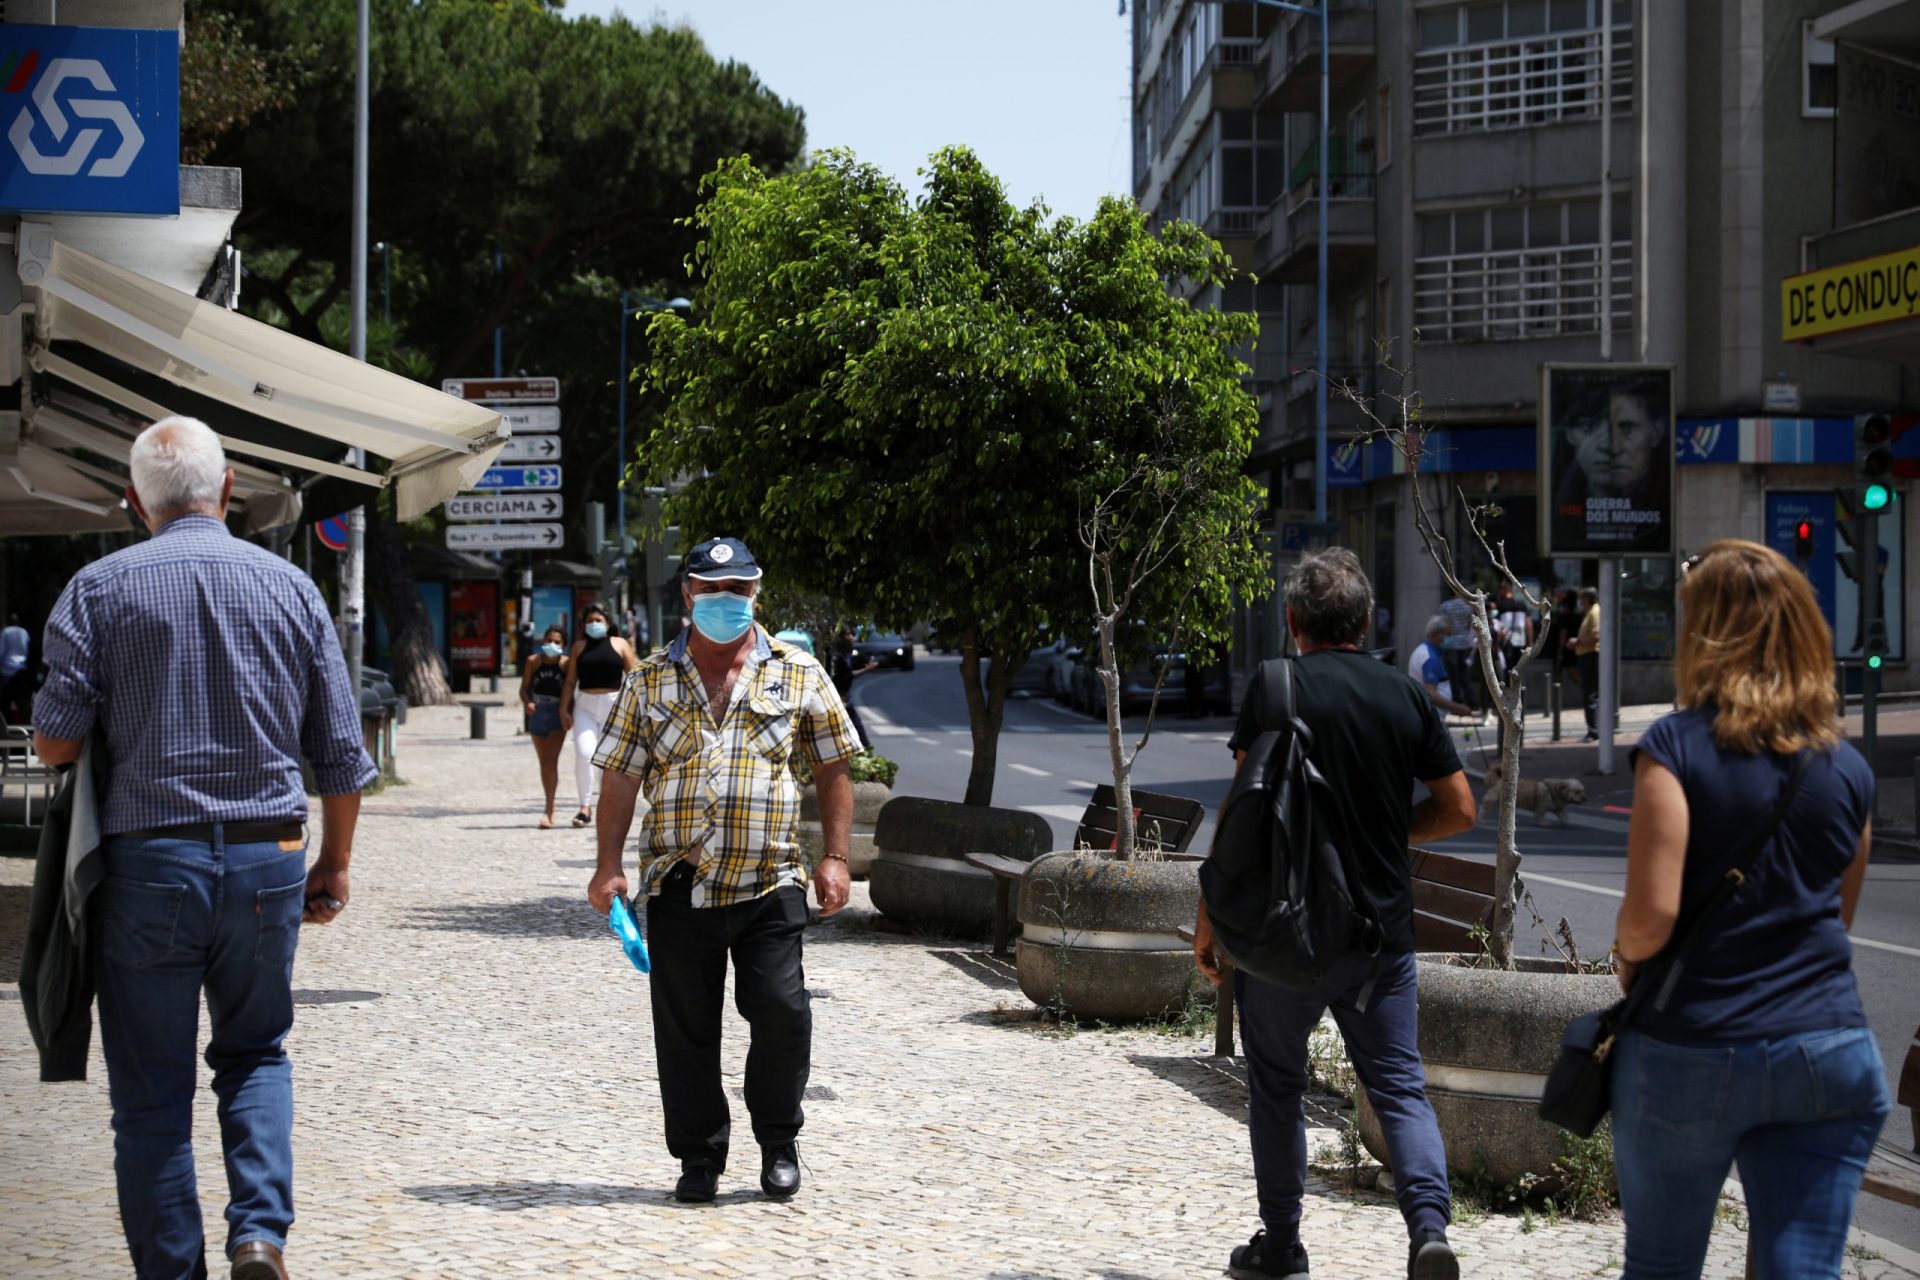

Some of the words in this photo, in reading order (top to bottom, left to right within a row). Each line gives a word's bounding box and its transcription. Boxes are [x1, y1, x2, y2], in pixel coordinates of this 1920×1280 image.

[1790, 284, 1817, 327] DE
[1822, 261, 1920, 319] CONDUÇ
[450, 501, 537, 514] CERCIAMA
[1586, 497, 1632, 510] GUERRA
[1586, 510, 1609, 524] DOS
[1611, 510, 1661, 524] MUNDOS
